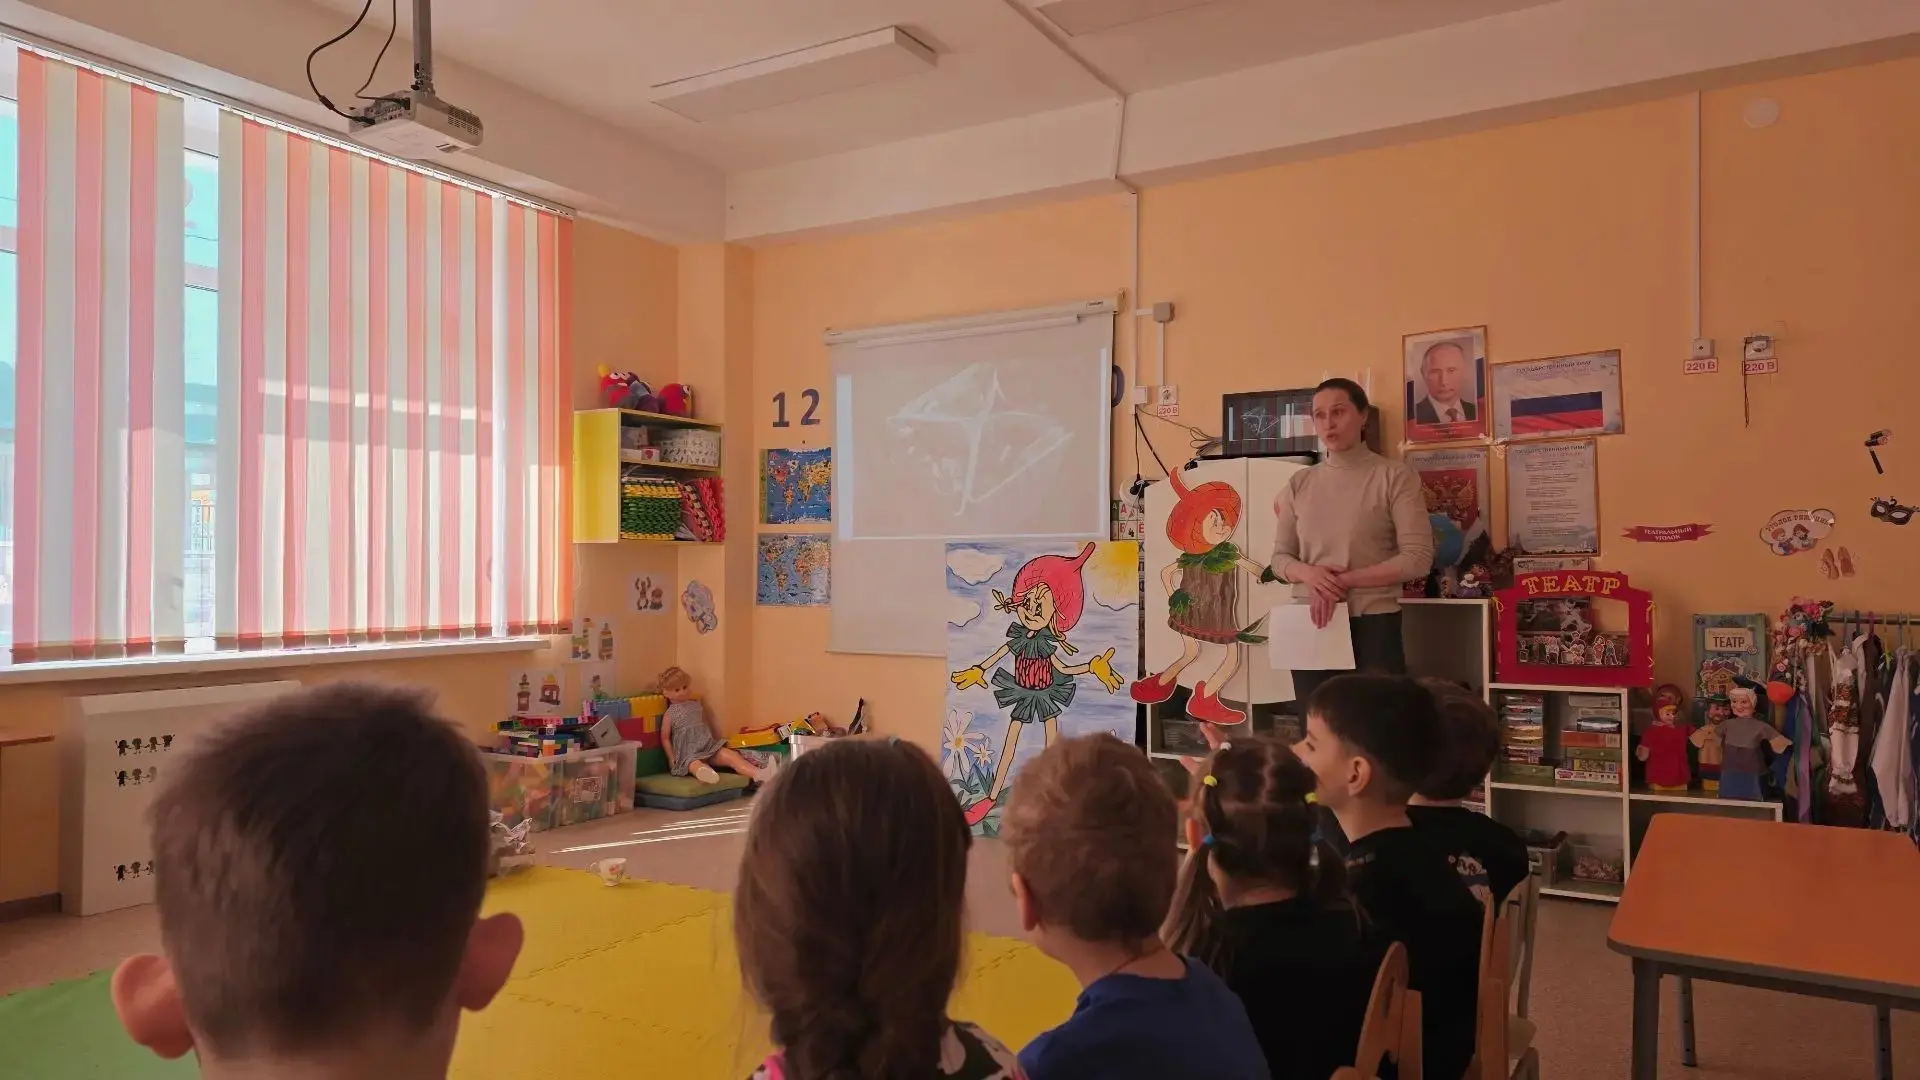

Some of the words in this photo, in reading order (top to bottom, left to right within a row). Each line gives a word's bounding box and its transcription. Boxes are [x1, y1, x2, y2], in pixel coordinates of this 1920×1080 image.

[1686, 361, 1706, 371] 220
[1744, 362, 1765, 372] 220
[1644, 527, 1692, 535] ТЕАТРАЛЬНЫЙ
[1521, 574, 1621, 595] ТЕАТР
[1712, 636, 1745, 648] ТЕАТР
